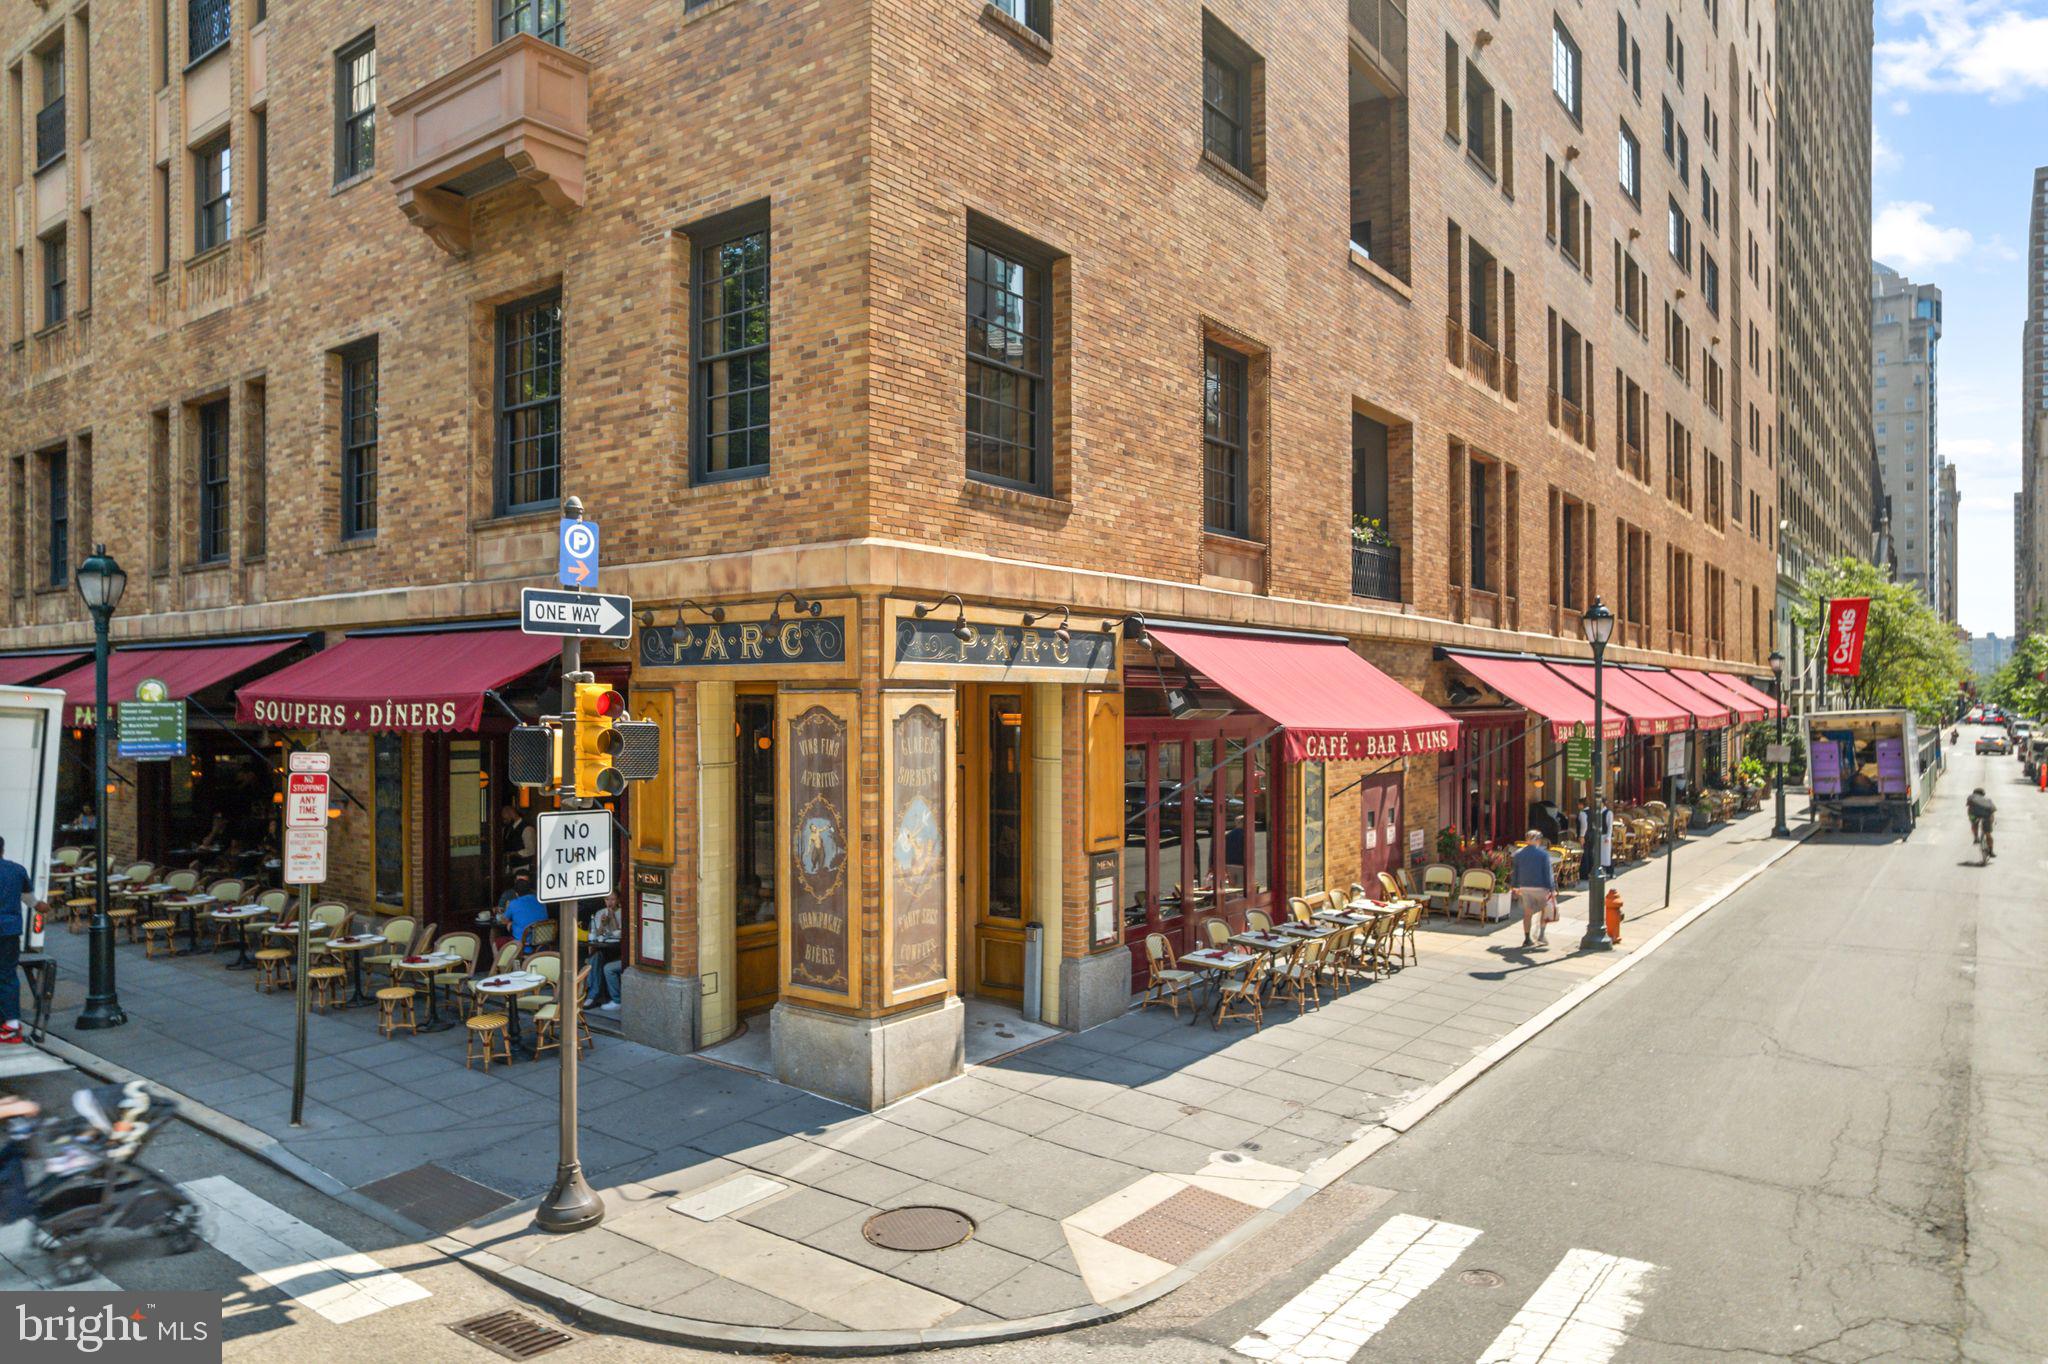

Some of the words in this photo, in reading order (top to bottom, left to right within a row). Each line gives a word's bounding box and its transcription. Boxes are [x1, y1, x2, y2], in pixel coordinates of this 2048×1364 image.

[535, 603, 566, 620] ONE
[572, 606, 600, 622] WAY
[1833, 608, 1856, 664] Curtis
[254, 700, 346, 726] SOUPERS
[370, 698, 456, 726] DÎNERS
[799, 737, 819, 757] VINS
[821, 736, 840, 758] FINS
[1306, 732, 1349, 757] CAFÉ
[1367, 735, 1396, 755] BAR
[1402, 730, 1412, 752] À
[1416, 729, 1449, 749] VINS
[304, 775, 314, 783] NO
[292, 784, 325, 793] STOPPING
[300, 796, 316, 804] ANY
[299, 805, 317, 814] TIME
[564, 823, 589, 840] NO
[555, 846, 597, 864] TURN
[546, 871, 568, 889] ON
[576, 869, 606, 886] RED
[637, 873, 662, 884] MENU
[804, 943, 836, 965] BIÈRE
